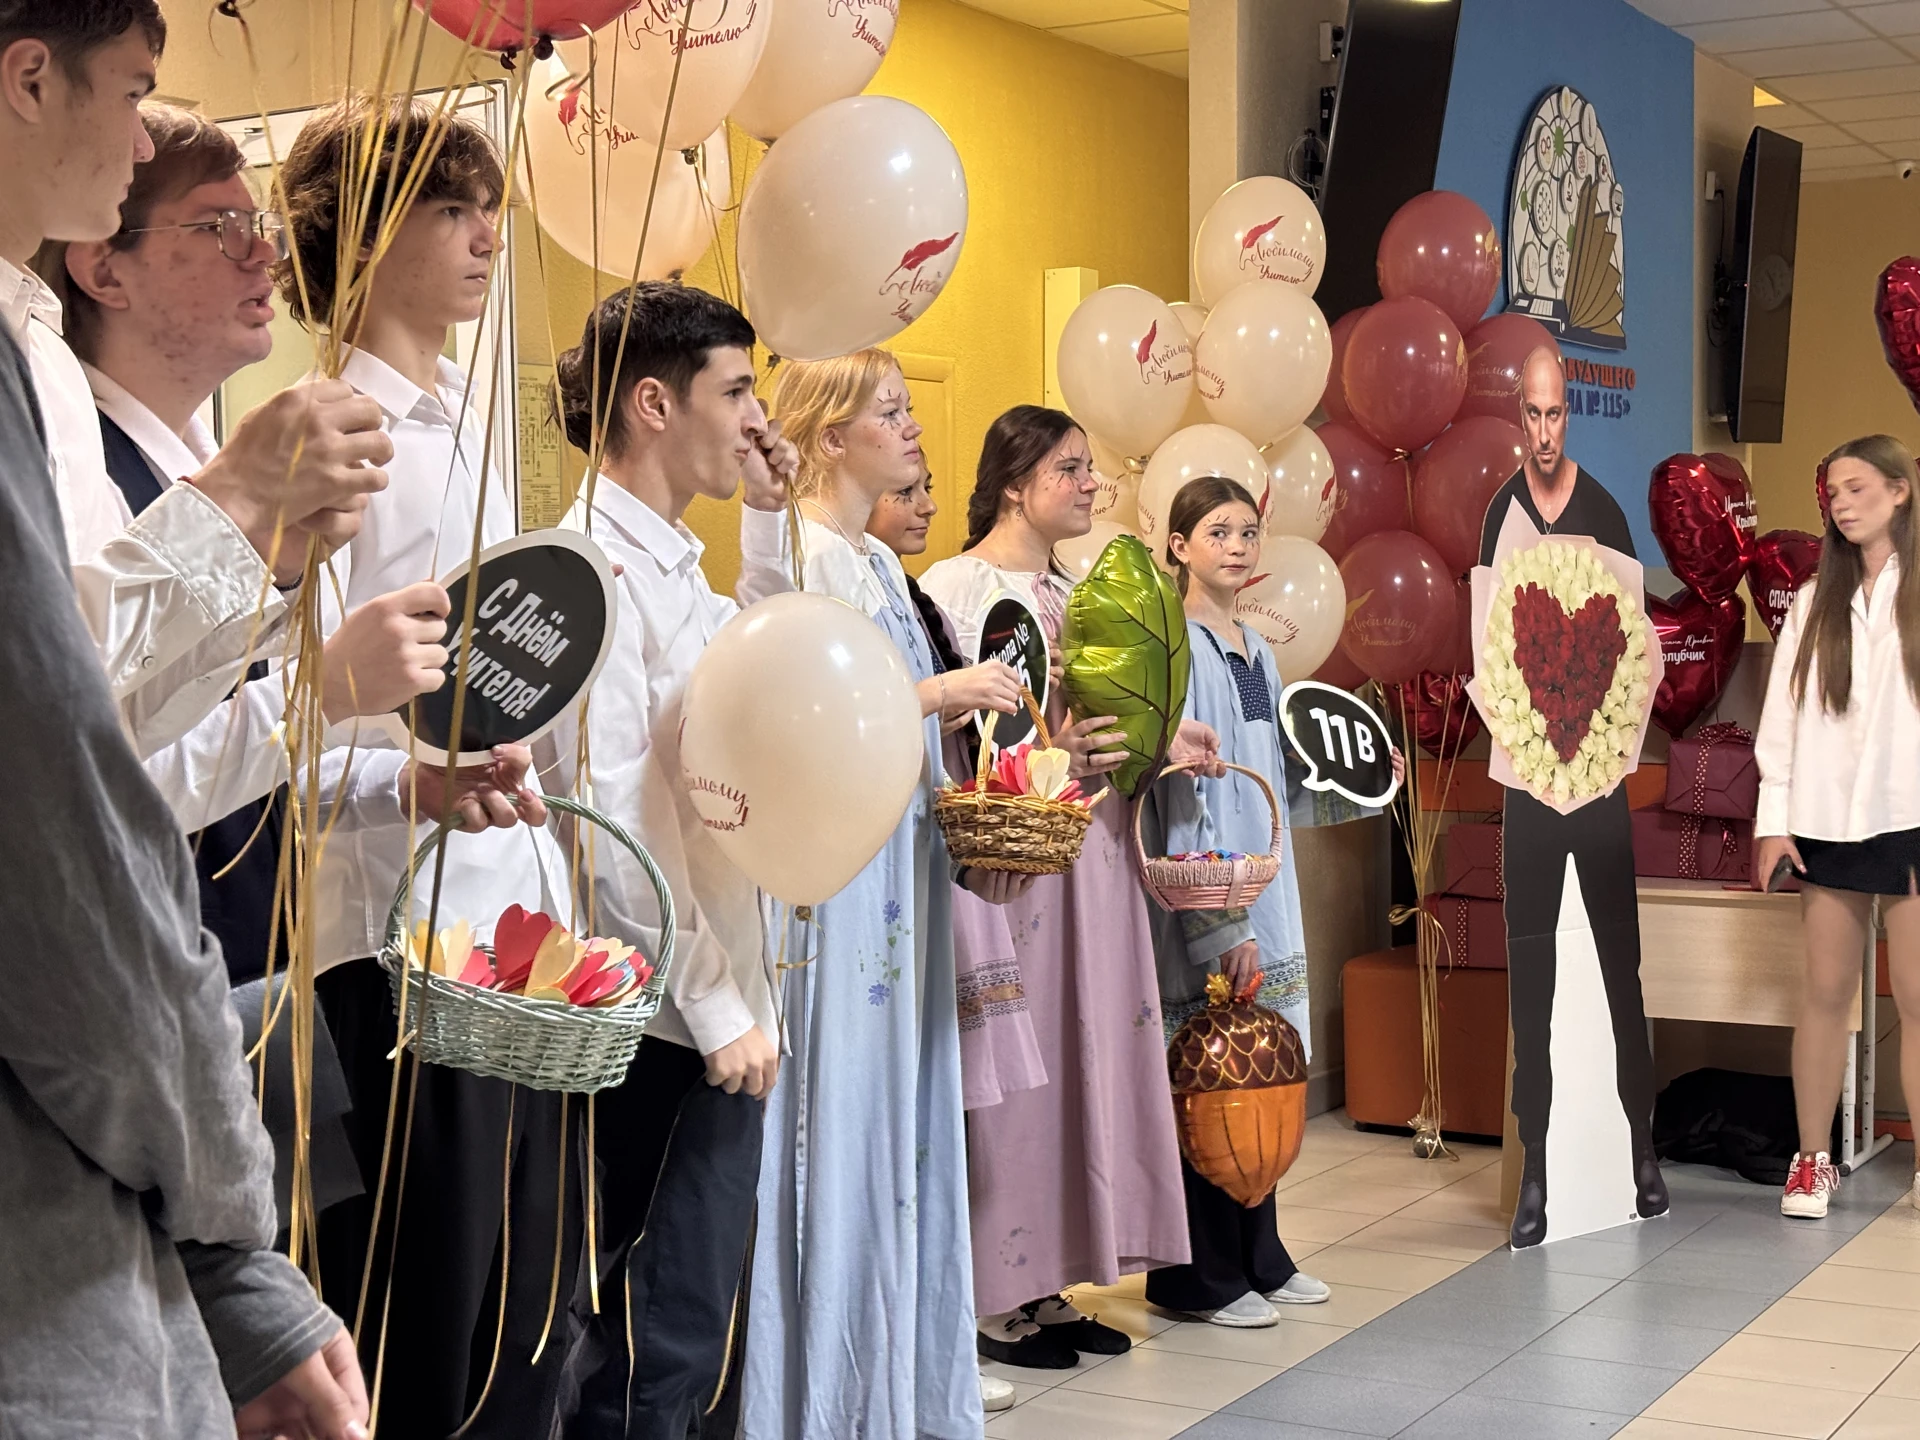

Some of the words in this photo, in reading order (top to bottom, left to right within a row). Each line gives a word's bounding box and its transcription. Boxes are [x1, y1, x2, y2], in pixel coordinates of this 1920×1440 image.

[1251, 240, 1315, 275] Любимому
[478, 578, 519, 620] С
[1768, 589, 1797, 609] СПАС
[488, 592, 571, 668] Днём
[1662, 648, 1706, 665] олубчик
